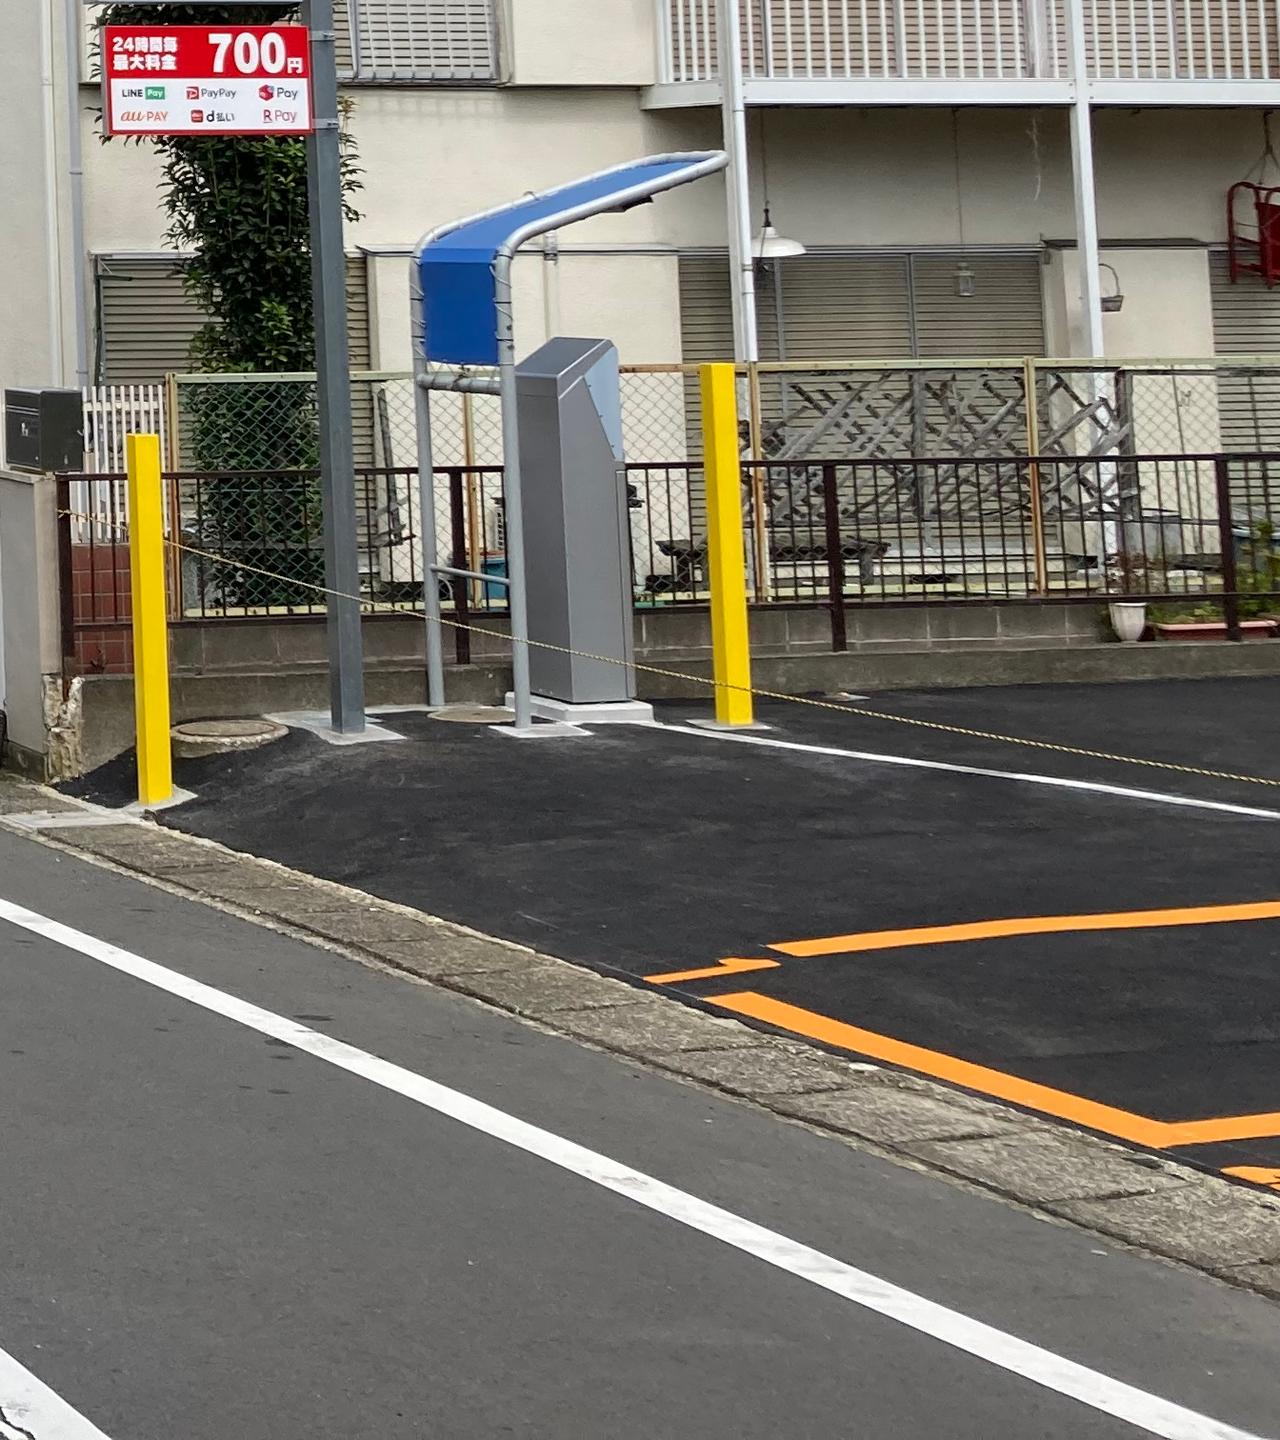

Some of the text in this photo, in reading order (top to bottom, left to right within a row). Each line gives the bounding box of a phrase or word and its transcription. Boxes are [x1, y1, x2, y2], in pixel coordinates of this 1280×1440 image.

[112, 36, 178, 53] 24時間毎
[113, 54, 177, 71] 最大料金
[122, 89, 163, 99] LINE Pay
[201, 88, 237, 100] PayPay
[276, 87, 298, 100] Pay
[147, 111, 168, 121] PAY
[275, 110, 297, 122] Pay
